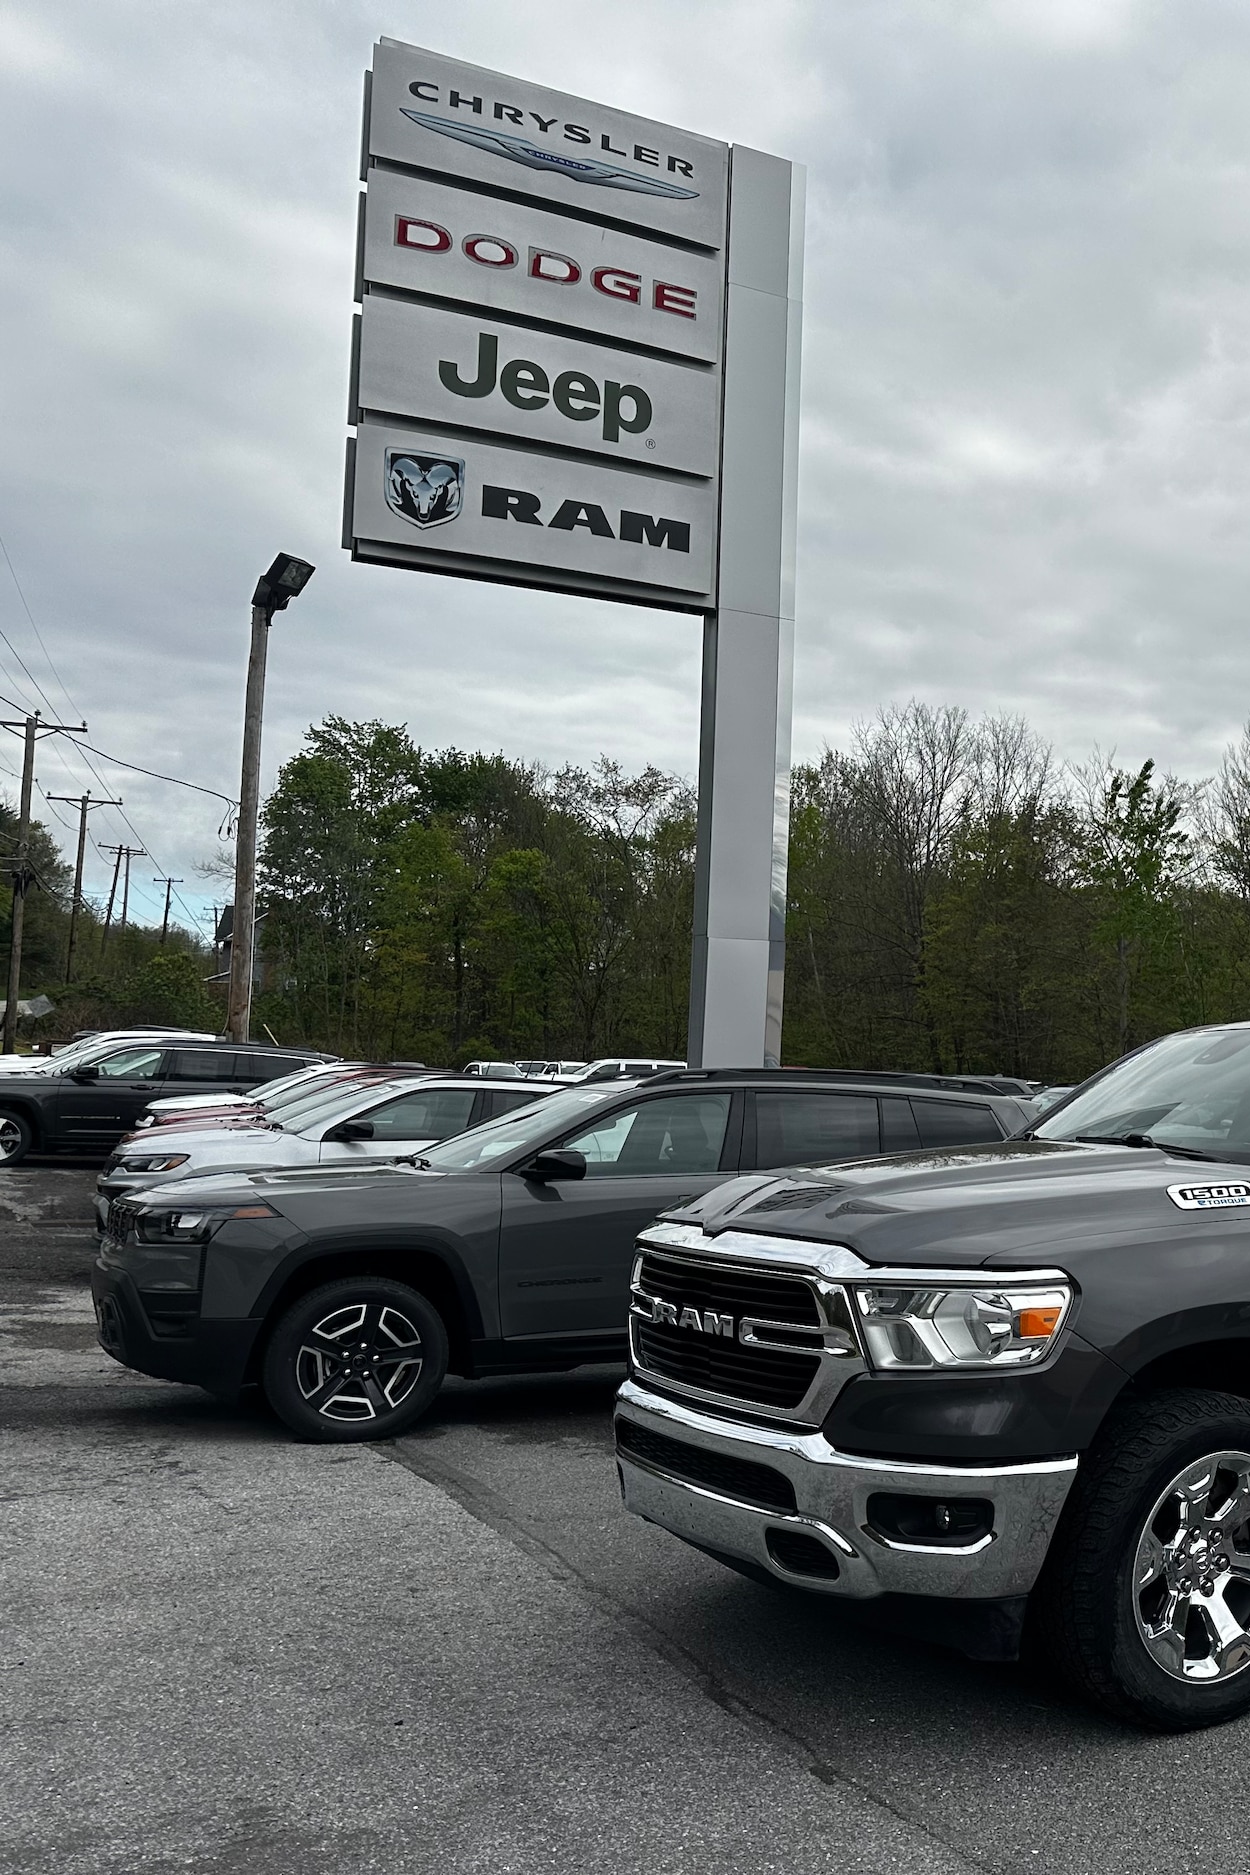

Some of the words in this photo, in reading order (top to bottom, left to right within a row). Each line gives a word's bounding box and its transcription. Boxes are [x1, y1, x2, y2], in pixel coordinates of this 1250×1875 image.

[409, 80, 695, 179] CHRYSLER
[528, 149, 586, 170] CHRYSLER
[393, 213, 698, 320] DODGE
[438, 332, 653, 443] Jeep
[481, 484, 690, 553] RAM
[1182, 1186, 1247, 1200] 1500
[655, 1301, 734, 1338] RAM
